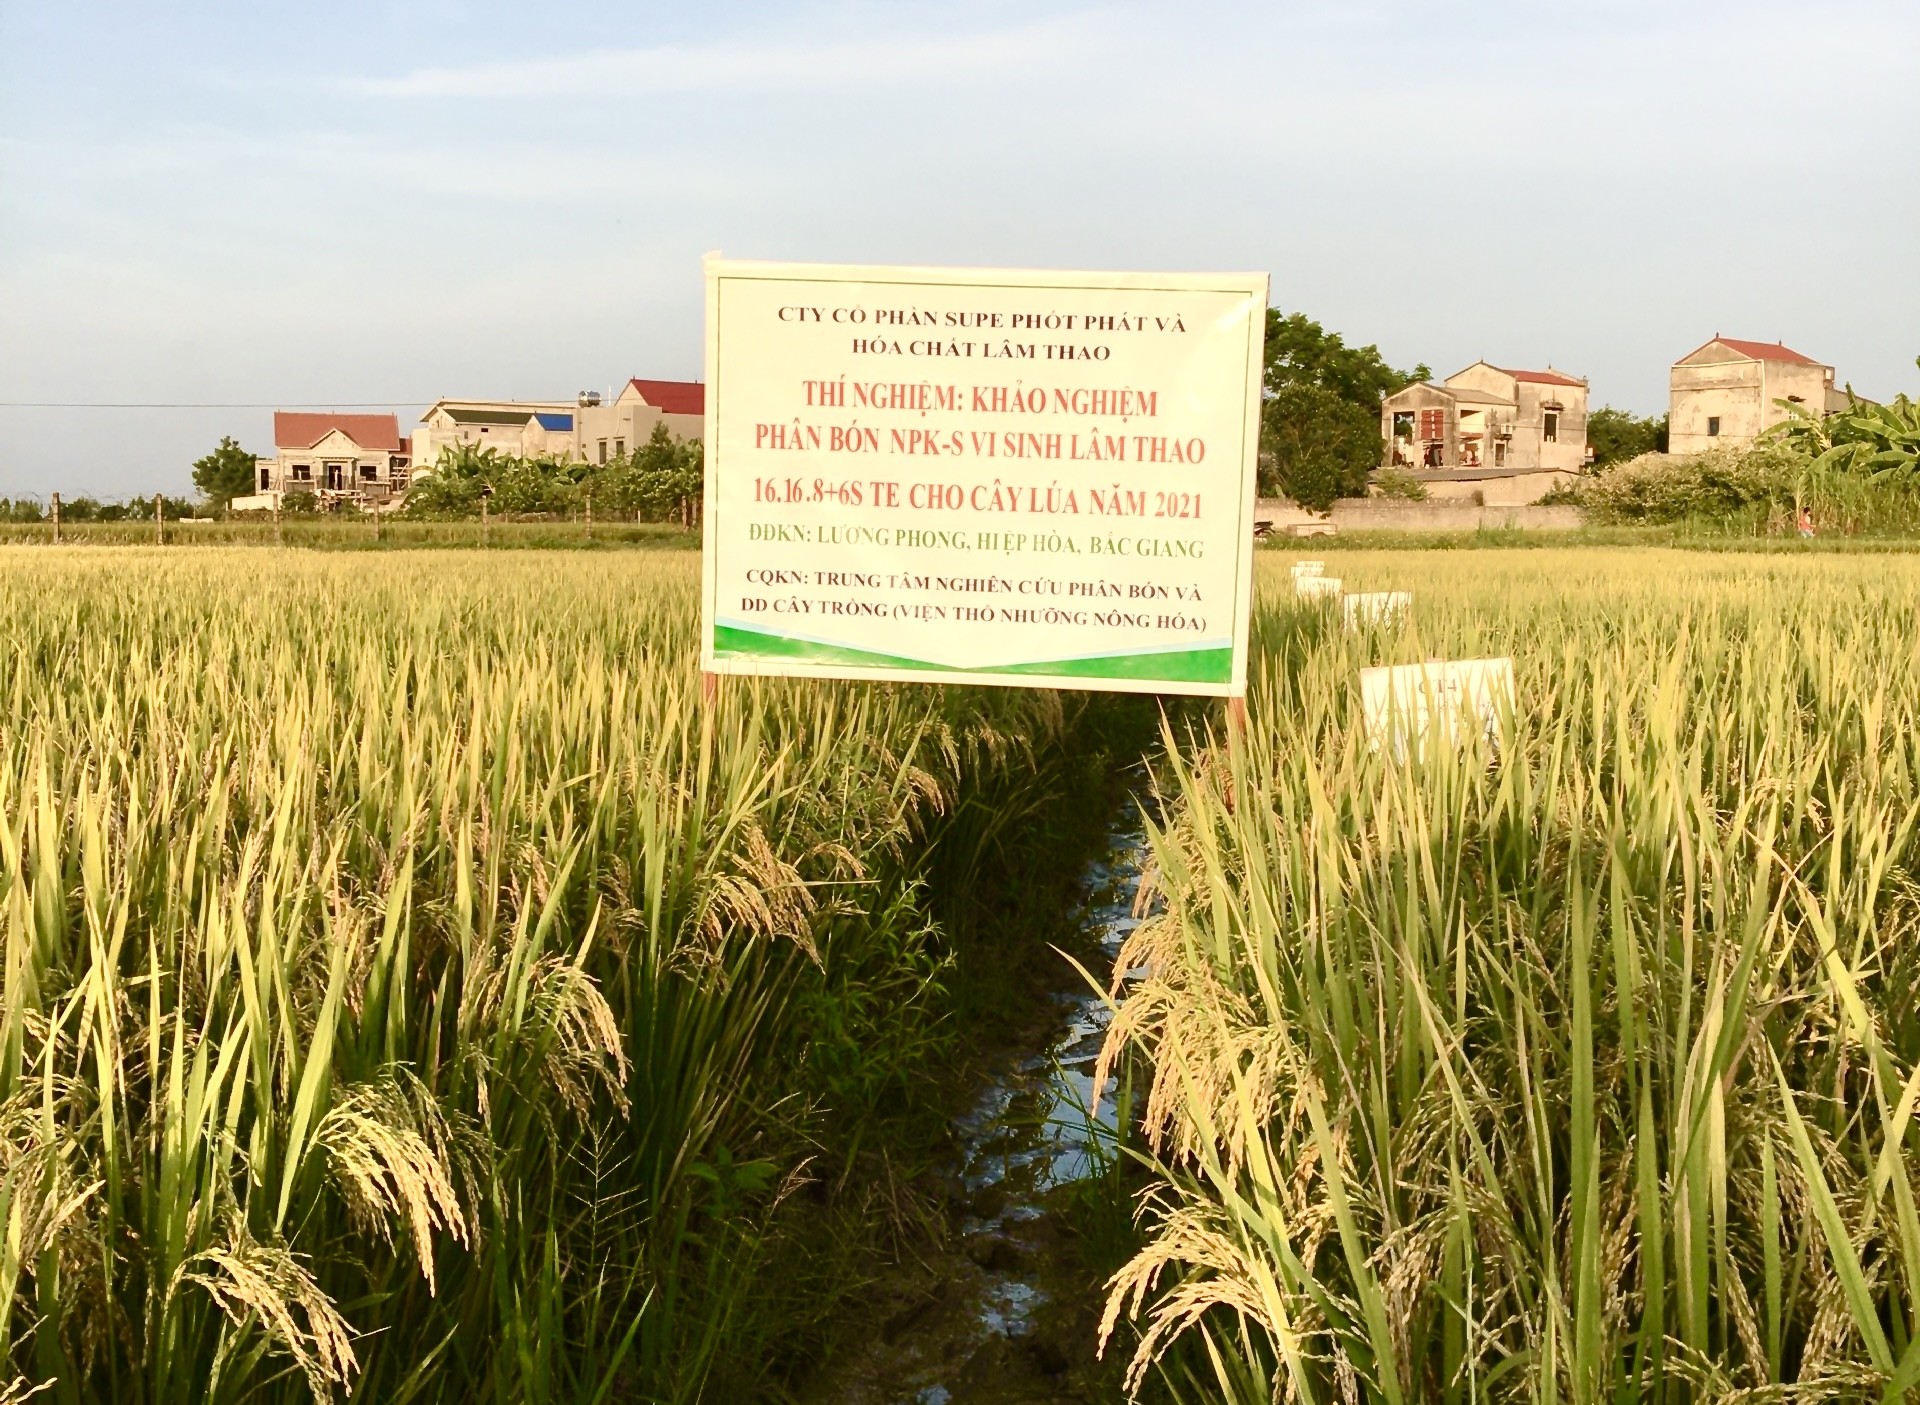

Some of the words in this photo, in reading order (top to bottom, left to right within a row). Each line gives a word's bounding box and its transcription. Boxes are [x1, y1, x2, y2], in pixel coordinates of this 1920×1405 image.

[778, 307, 826, 322] CTY
[945, 311, 1004, 328] SUPE
[1084, 311, 1148, 332] PHÁT
[1155, 313, 1186, 333] VÀ
[852, 335, 903, 355] HÓA
[983, 339, 1036, 359] LÂM
[1043, 345, 1111, 361] THAO
[802, 373, 845, 408] THÍ
[852, 380, 963, 418] NGHIỆM:
[971, 379, 1047, 414] KHẢO
[1052, 386, 1158, 424] NGHIỆM
[755, 417, 822, 450] PHÂN
[829, 419, 880, 453] BÓN
[889, 428, 964, 457] NPK-S
[970, 431, 997, 457] VI
[1003, 432, 1062, 459] SINH
[1069, 427, 1127, 462] LÂM
[1133, 436, 1206, 465] THAO
[754, 477, 863, 506] 16.16.8+6S
[869, 481, 900, 508] TE
[909, 483, 964, 511] CHO
[970, 478, 1023, 513] CÂY
[1028, 480, 1080, 514] LÚA
[1088, 482, 1147, 517] NĂM
[1154, 491, 1202, 519] 2021
[749, 523, 812, 543] ĐĐKN:
[817, 524, 890, 546] LƯƠNG
[895, 529, 971, 553] PHONG,
[1032, 529, 1082, 555] HÒA,
[1136, 538, 1205, 559] GIANG
[746, 569, 809, 586] CQKN:
[814, 571, 881, 588] TRUNG
[886, 571, 930, 590] TÂM
[936, 575, 1013, 593] NGHIÊN
[1018, 576, 1063, 596] CỨU
[1068, 579, 1123, 598] PHÂN
[1128, 581, 1170, 600] BÓN
[1175, 583, 1203, 602] VÀ
[741, 597, 768, 612] DD
[773, 595, 814, 614] CÂY
[893, 602, 947, 623] (VIỆN
[1000, 607, 1088, 627] NHƯỠNG
[1093, 609, 1151, 629] NÔNG
[1156, 611, 1208, 634] HÓA)
